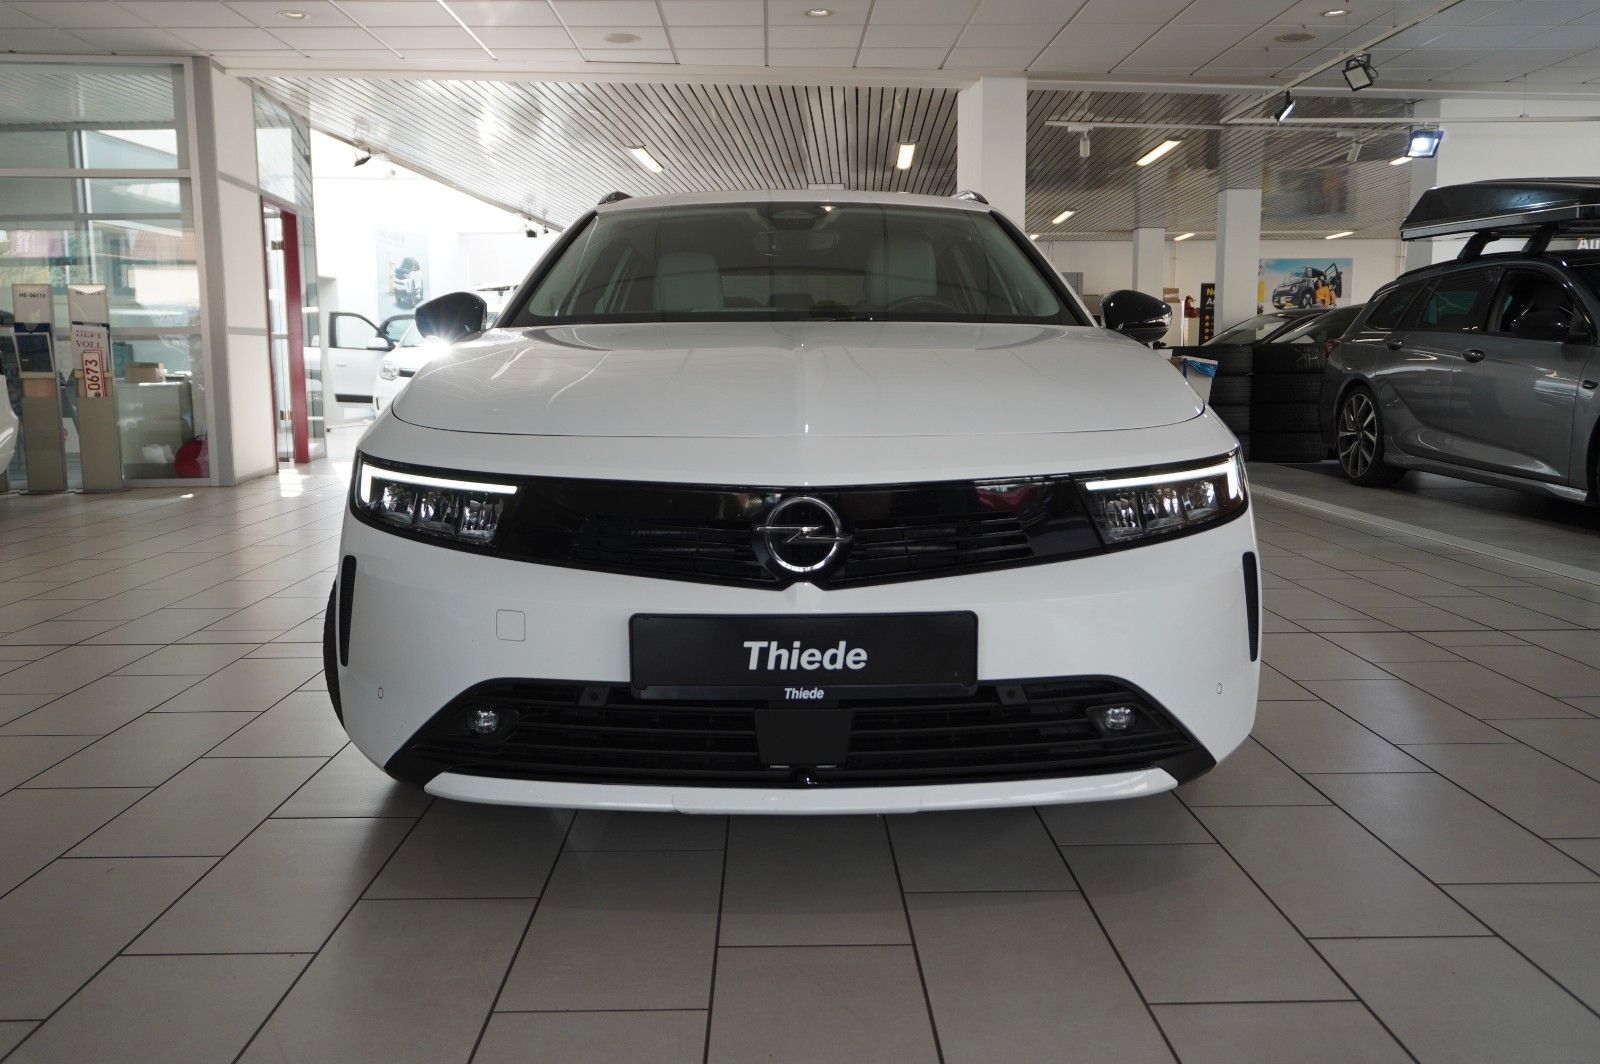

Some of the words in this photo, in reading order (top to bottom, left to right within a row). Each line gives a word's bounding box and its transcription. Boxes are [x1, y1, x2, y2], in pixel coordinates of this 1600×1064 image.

[84, 359, 101, 391] 0673
[743, 640, 868, 671] Thiede
[784, 687, 825, 700] Thiede
